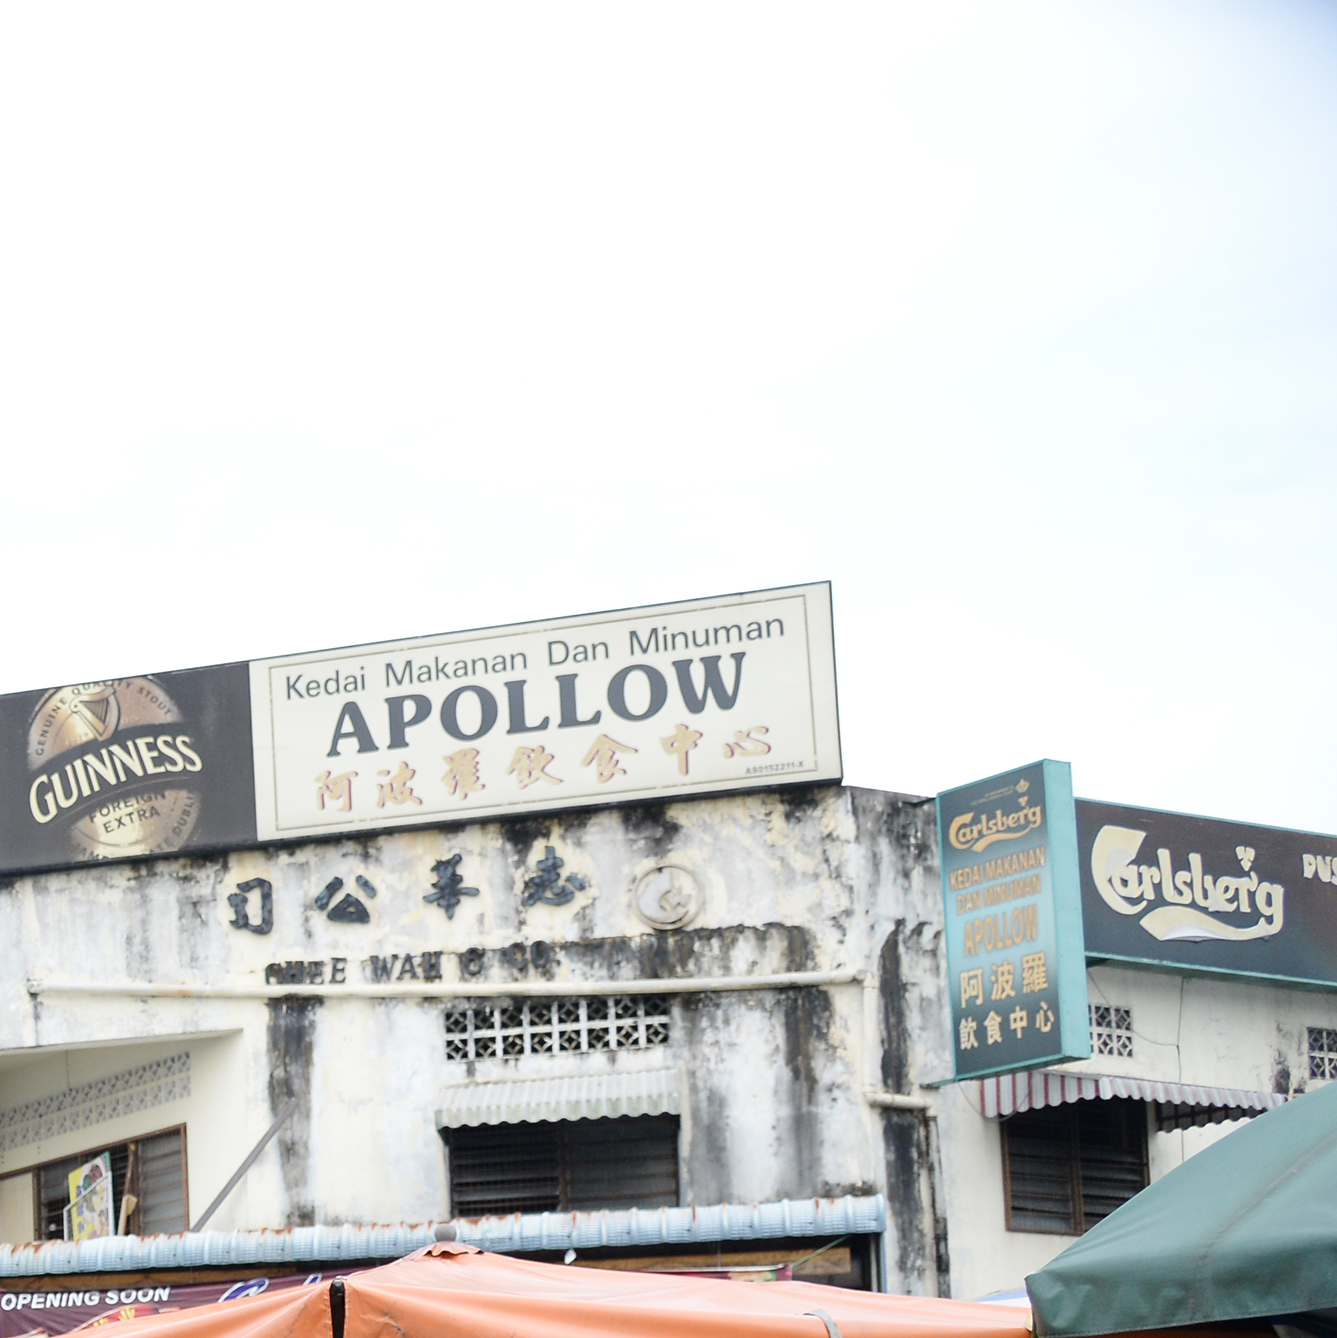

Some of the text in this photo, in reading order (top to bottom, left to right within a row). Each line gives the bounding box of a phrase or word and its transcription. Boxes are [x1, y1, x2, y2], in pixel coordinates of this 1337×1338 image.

[285, 617, 785, 701] Kedai Makanan Dan Minuman
[35, 696, 68, 757] GENUINE
[136, 684, 173, 717] STOUT
[326, 651, 747, 758] APOLLOW
[28, 734, 204, 825] GUINNESS
[103, 805, 161, 834] EXTRA
[948, 804, 1043, 853] Carlsberg
[950, 846, 1046, 892] KEDAI MAKANAN
[956, 873, 1042, 916] DAN MINUMAN
[1090, 824, 1286, 942] Carlsberg
[963, 902, 1039, 958] APOLLOW
[369, 950, 444, 983] WAH
[959, 951, 1050, 1009] 阿波羅
[958, 1000, 1056, 1051] 飲食中心
[0, 1286, 172, 1312] OPENING SOON
